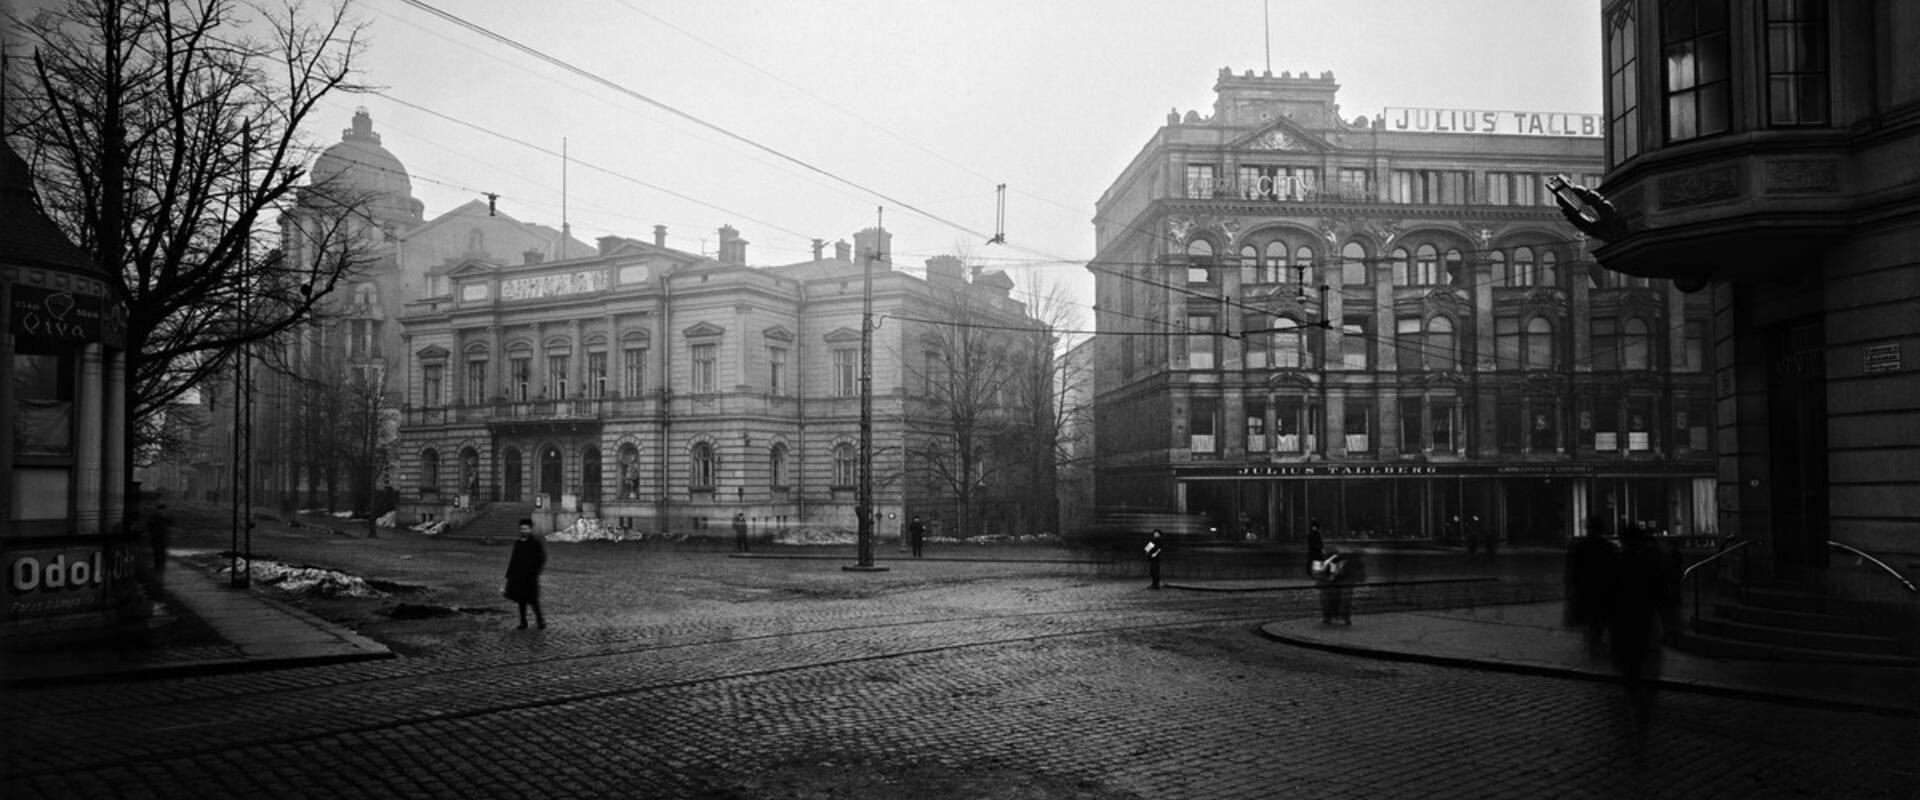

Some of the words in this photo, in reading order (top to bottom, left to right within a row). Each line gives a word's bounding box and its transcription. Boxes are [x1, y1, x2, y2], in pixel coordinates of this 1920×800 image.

[1395, 109, 1496, 132] JULIUS
[1256, 175, 1309, 198] CITY
[1237, 466, 1315, 475] JULIUS
[1327, 465, 1437, 475] TALLBERG
[12, 551, 103, 591] Odol
